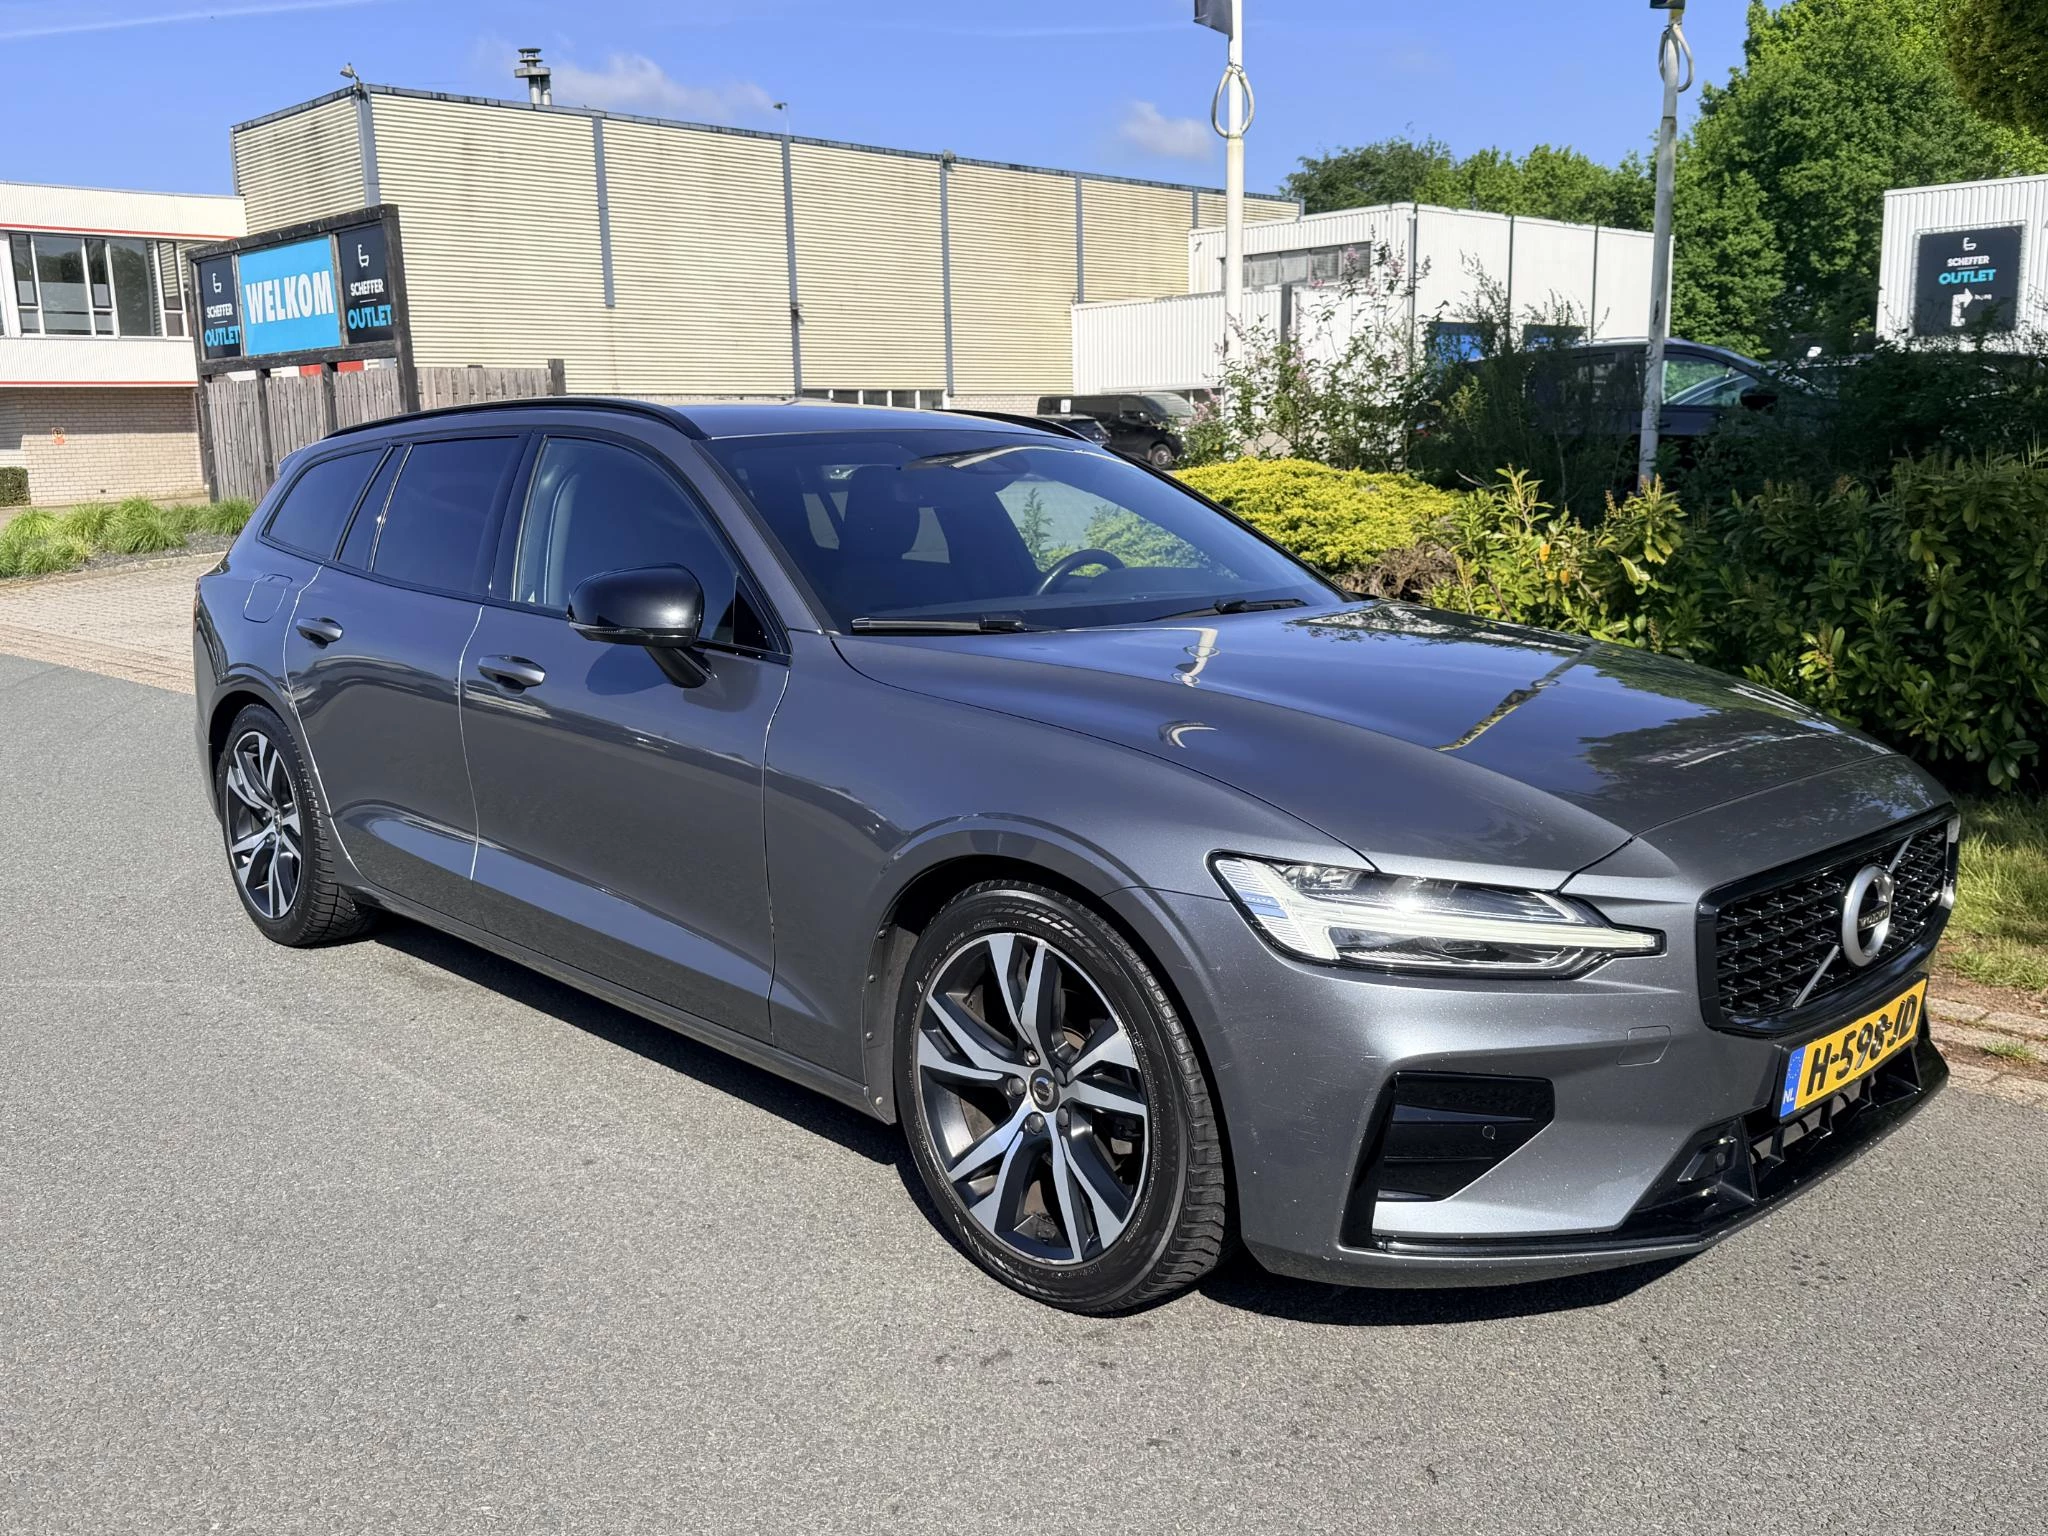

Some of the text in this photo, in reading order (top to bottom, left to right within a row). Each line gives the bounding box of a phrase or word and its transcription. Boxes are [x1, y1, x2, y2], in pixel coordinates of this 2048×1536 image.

[1947, 256, 1989, 267] SCHEFFER
[1938, 269, 1996, 284] OUTLET
[350, 279, 384, 296] SCHEFFER
[245, 271, 334, 323] WELKOM
[206, 304, 233, 318] SCHEFFER
[348, 304, 391, 329] OUTLET
[205, 326, 239, 346] OUTLET
[1783, 1088, 1794, 1104] NL
